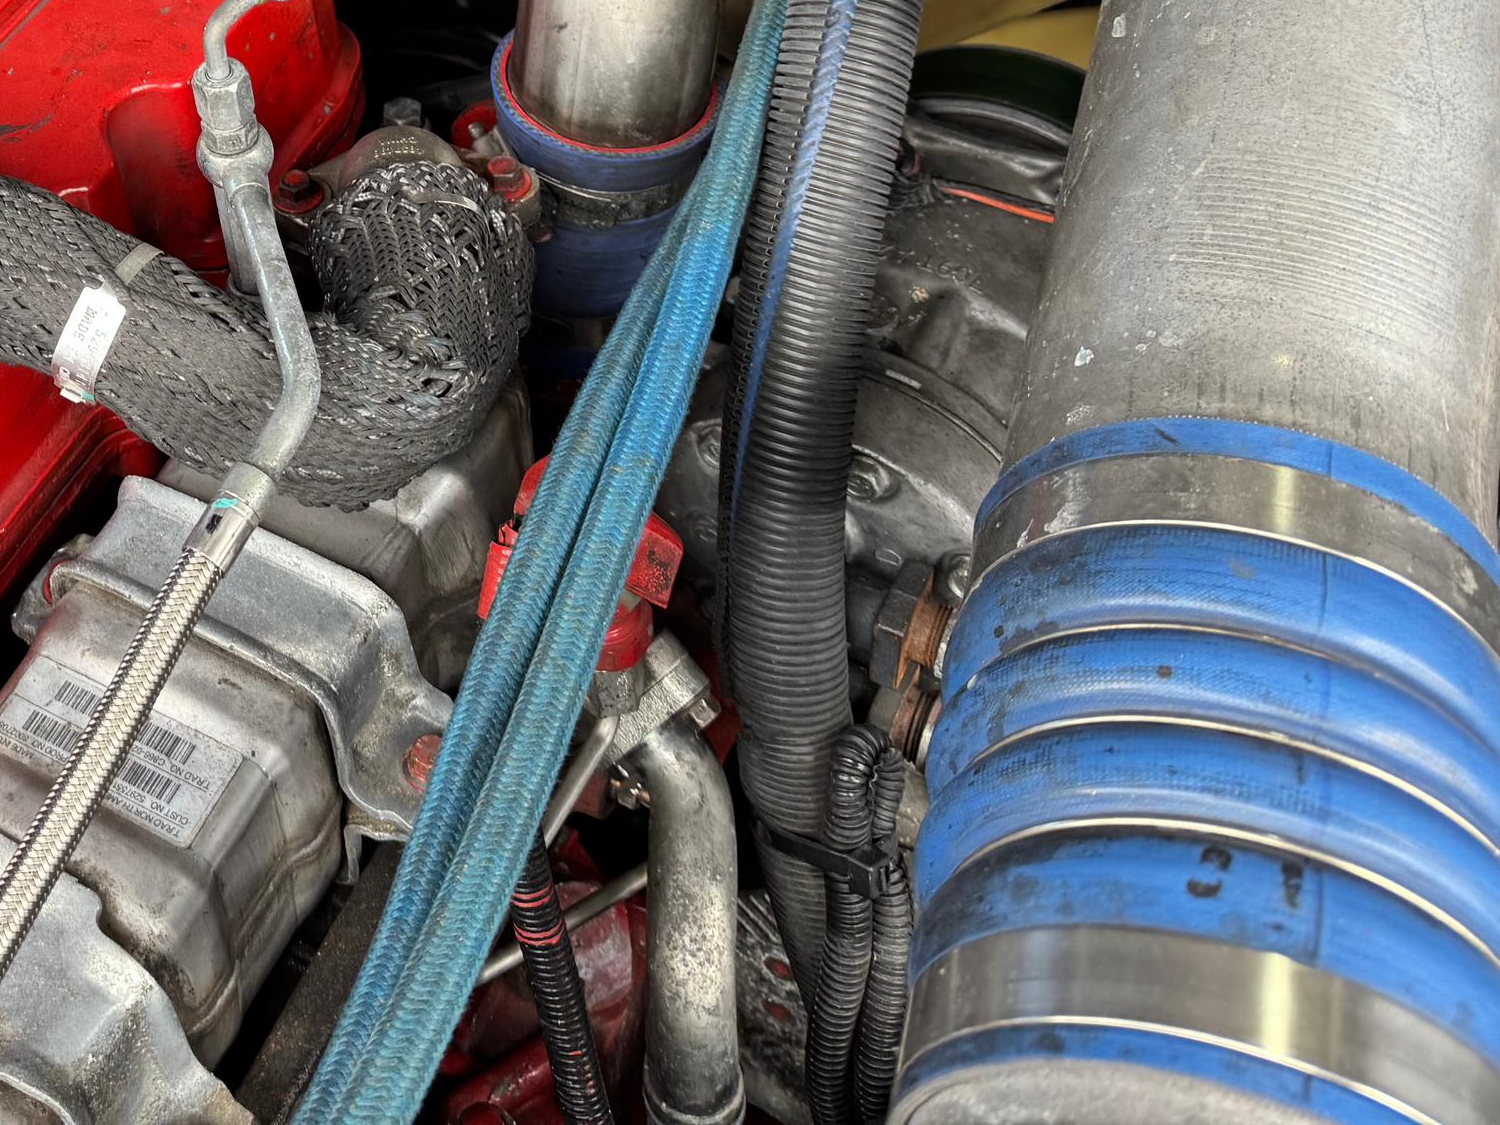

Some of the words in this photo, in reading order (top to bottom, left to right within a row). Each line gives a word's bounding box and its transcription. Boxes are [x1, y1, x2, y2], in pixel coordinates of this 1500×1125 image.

[10, 742, 35, 760] MADE
[43, 745, 68, 763] PROD
[120, 801, 155, 824] NORTH
[163, 807, 190, 826] CUST
